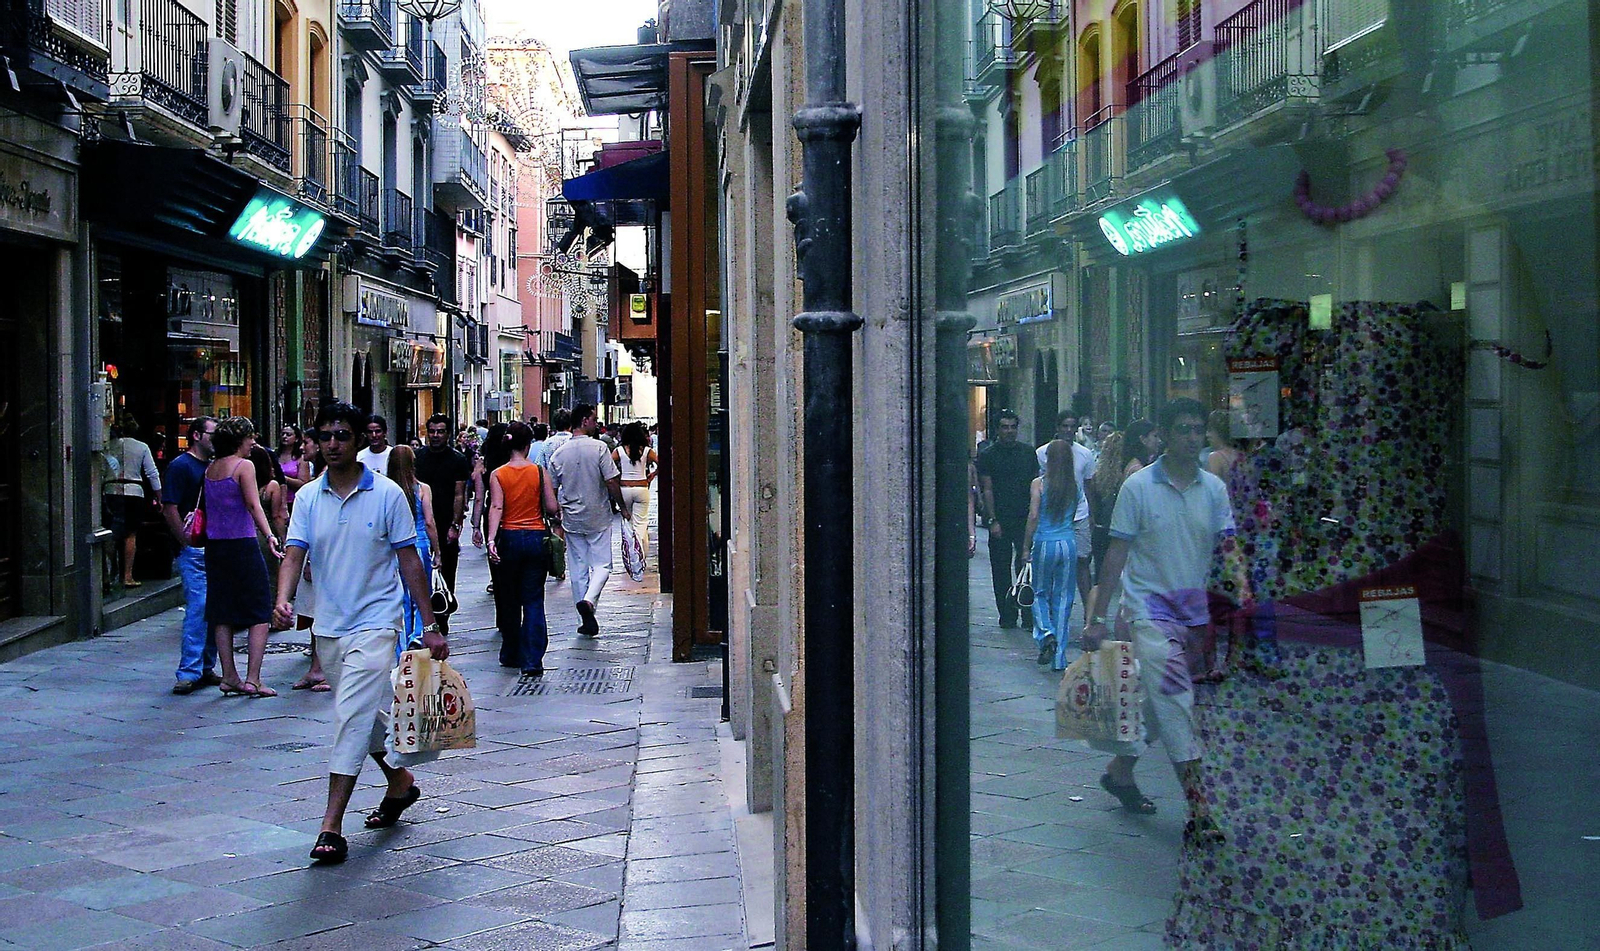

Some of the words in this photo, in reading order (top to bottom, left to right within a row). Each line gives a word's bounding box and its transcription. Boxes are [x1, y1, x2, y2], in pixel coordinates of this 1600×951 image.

[1231, 360, 1275, 369] REBAJAS
[1362, 586, 1414, 598] REBAJAS
[403, 653, 416, 746] REBAJAS
